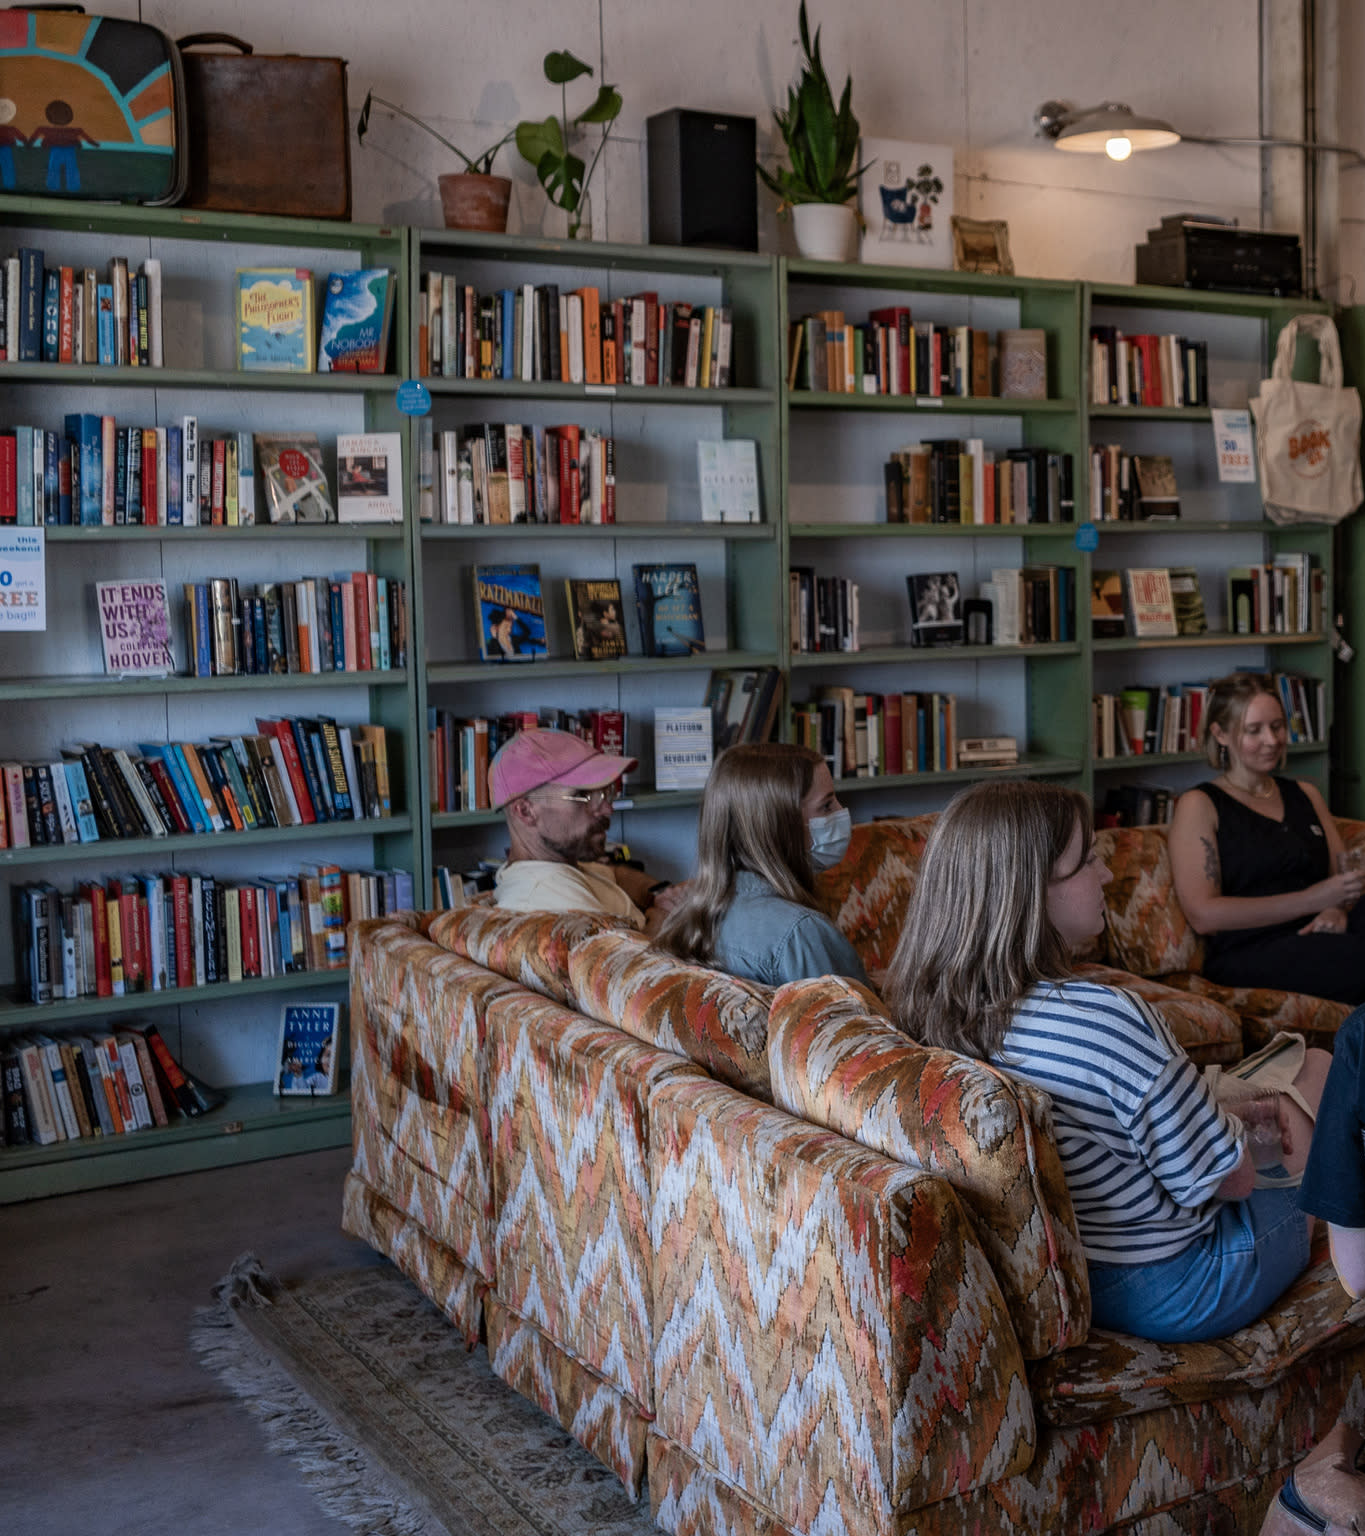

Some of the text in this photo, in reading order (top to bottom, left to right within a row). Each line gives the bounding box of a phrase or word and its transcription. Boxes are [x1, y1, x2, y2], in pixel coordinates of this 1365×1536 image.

[331, 338, 378, 350] NOBODY
[17, 536, 38, 544] this
[642, 570, 692, 584] HARPER
[101, 585, 165, 604] IT ENDS
[657, 584, 681, 596] LEE
[103, 603, 147, 621] WITH
[105, 622, 129, 639] US
[120, 641, 160, 652] COLLEEN
[110, 651, 172, 669] HOOVER
[666, 722, 703, 732] PLATFORM
[664, 754, 707, 763] REVOLUTION
[292, 1009, 328, 1020] ANNE
[289, 1021, 330, 1033] TYLER
